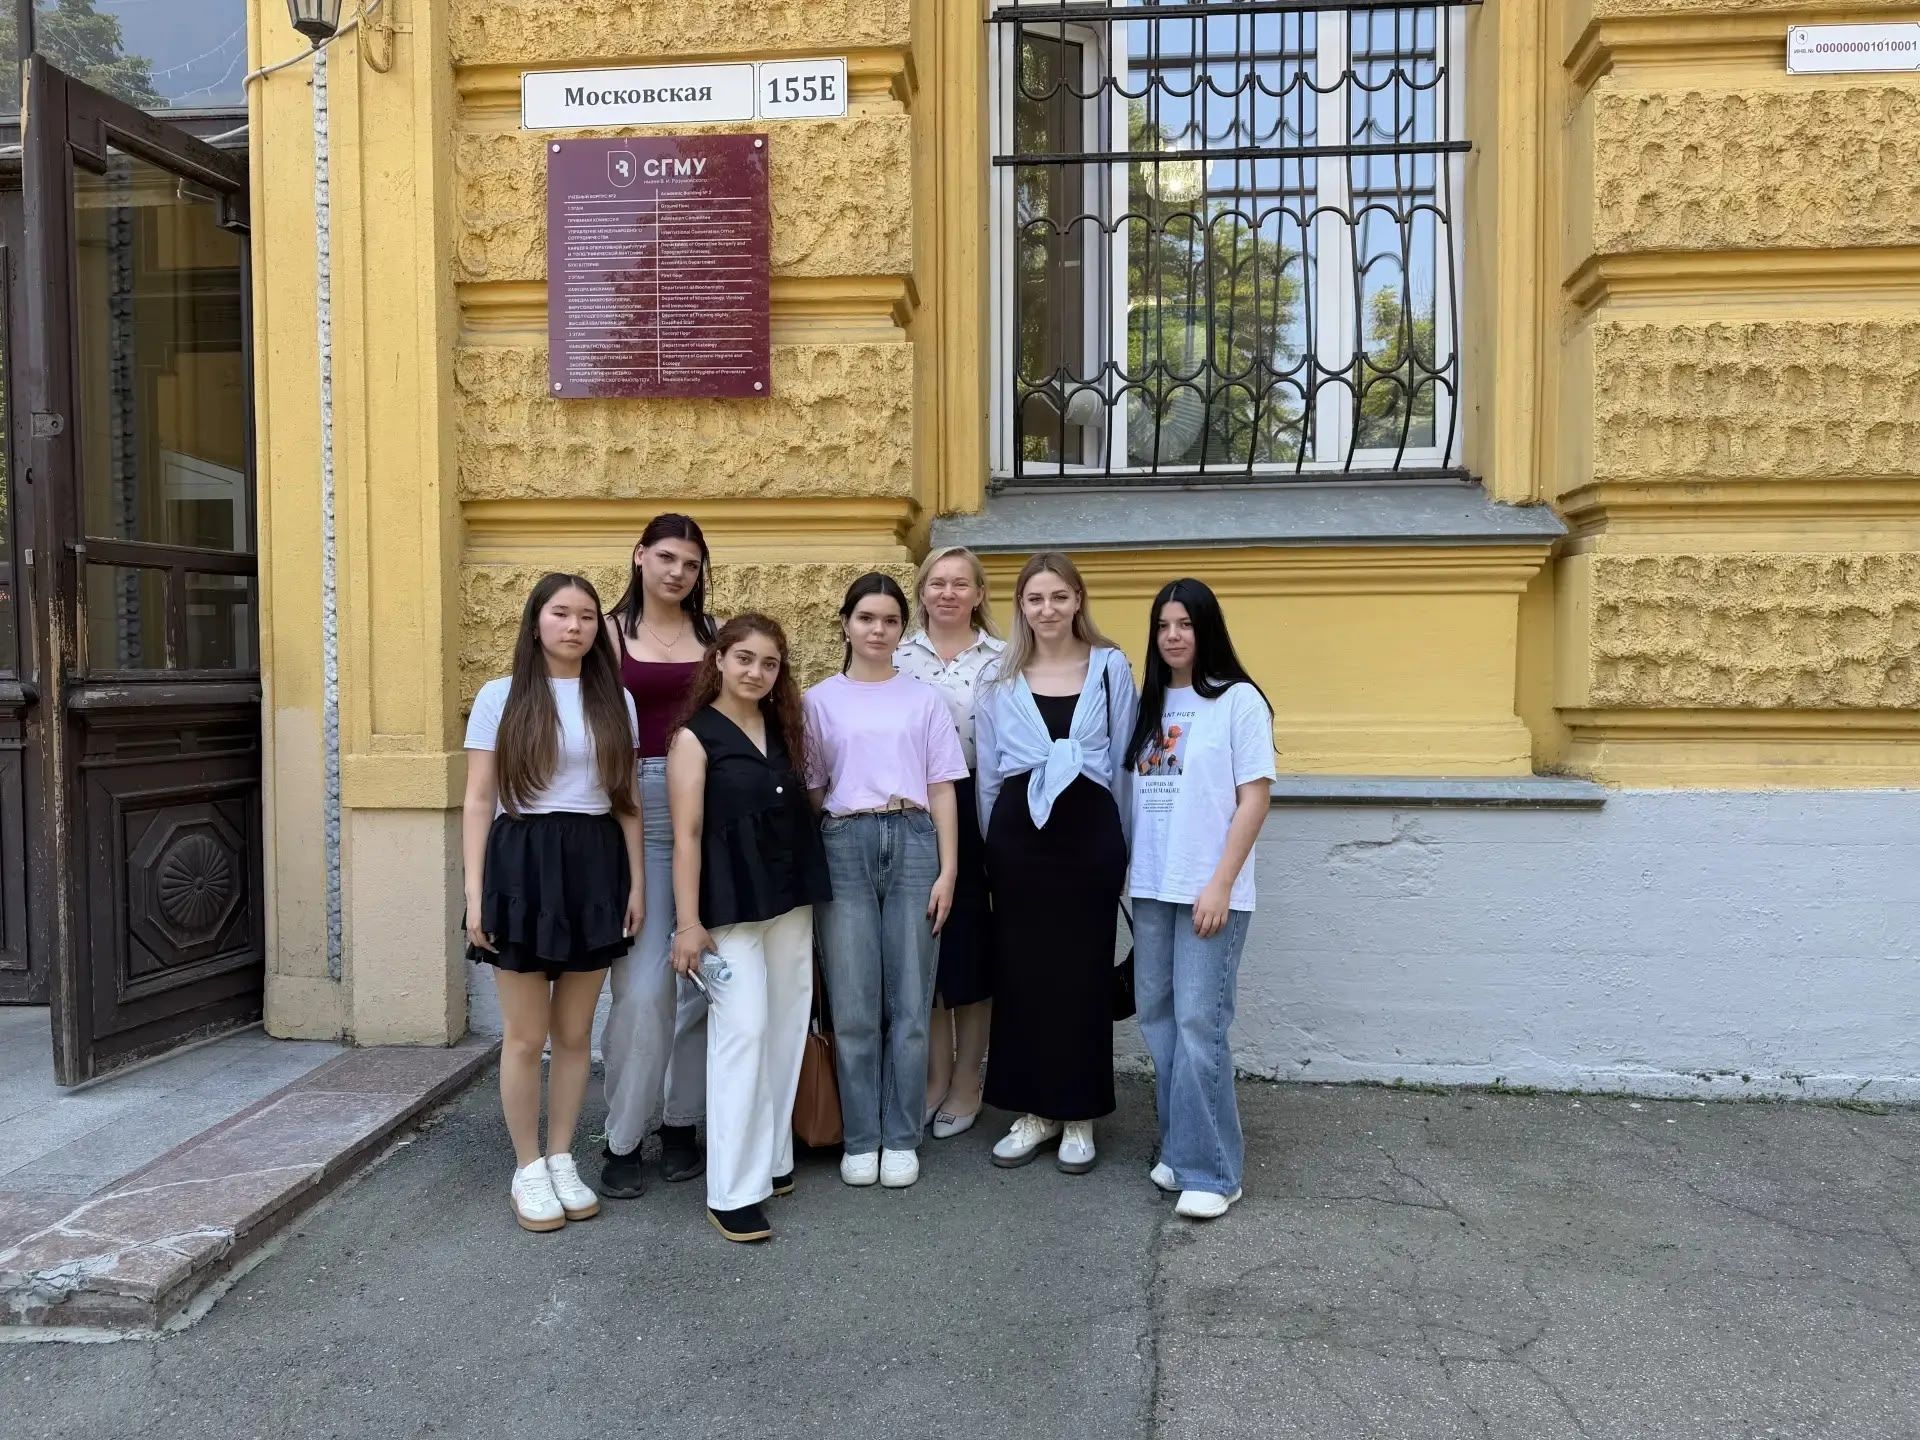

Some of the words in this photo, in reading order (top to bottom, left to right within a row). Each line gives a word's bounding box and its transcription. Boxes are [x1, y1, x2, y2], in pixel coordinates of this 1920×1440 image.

[1815, 40, 1917, 54] 000000001010001
[564, 86, 713, 107] Московская
[643, 157, 707, 177] СГМУ
